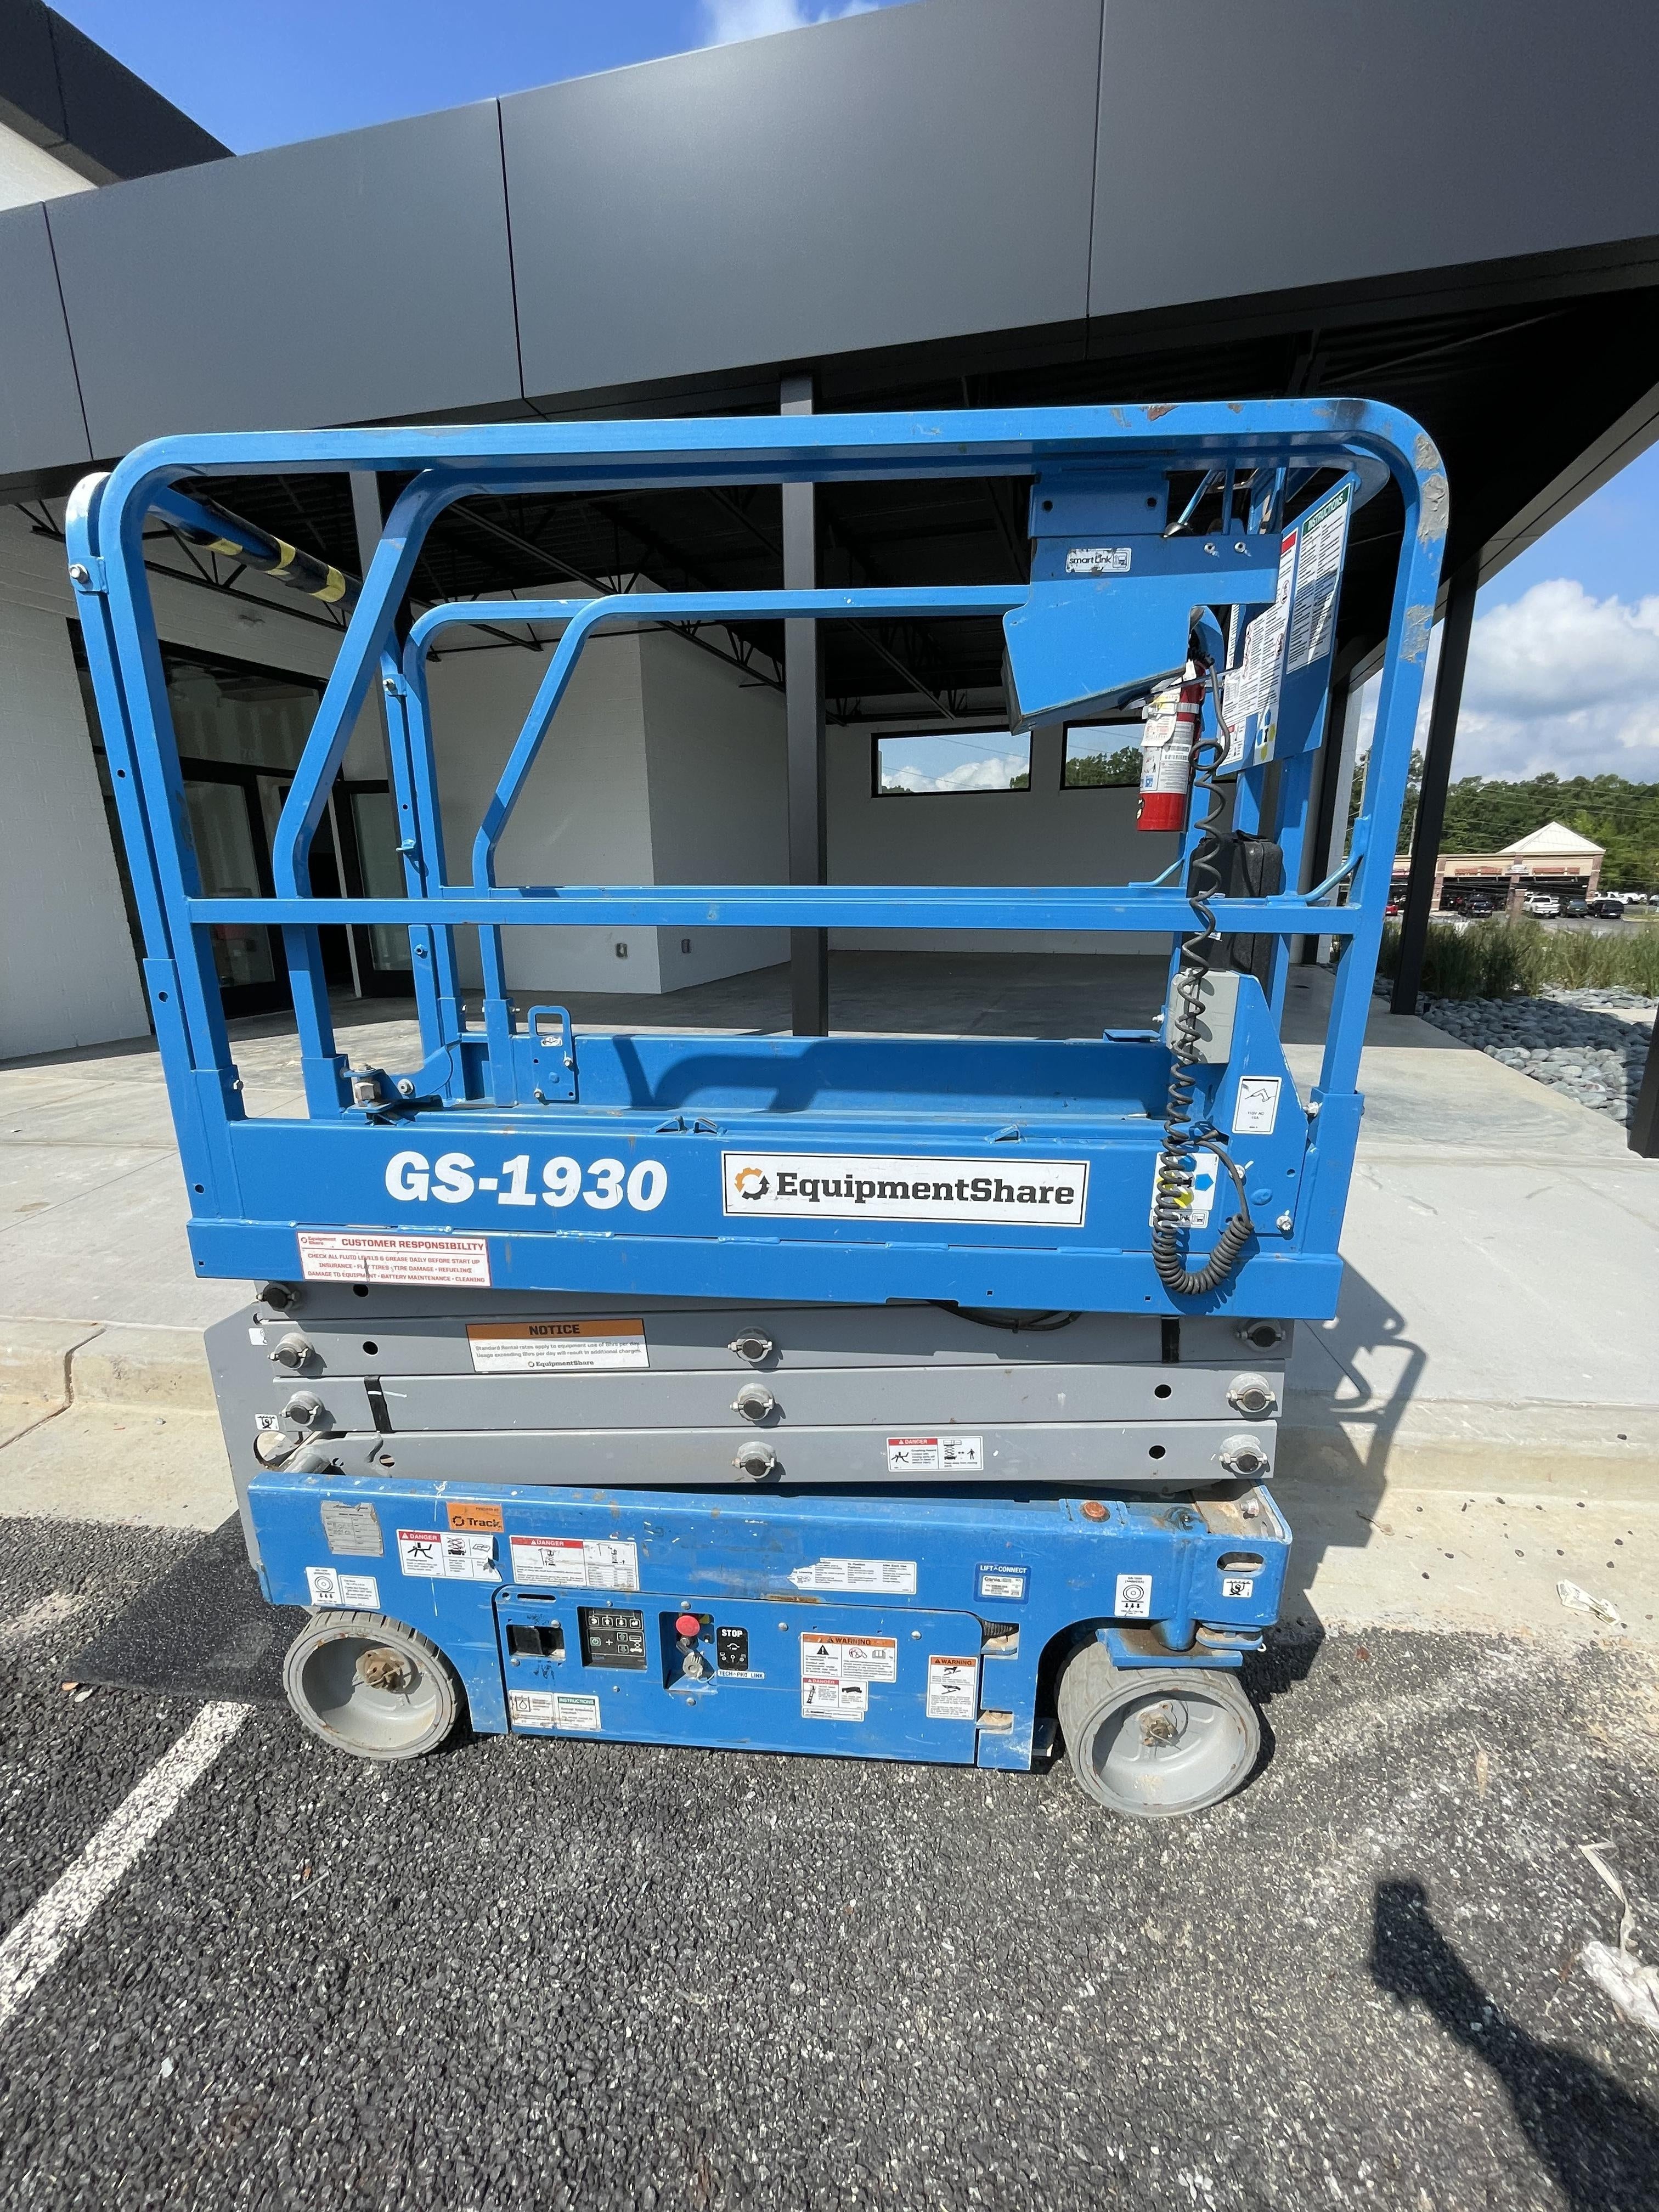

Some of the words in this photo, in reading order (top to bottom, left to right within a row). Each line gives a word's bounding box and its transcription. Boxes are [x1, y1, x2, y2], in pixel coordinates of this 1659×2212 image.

[1308, 493, 1344, 531] INSTRUCTIONS
[385, 1151, 668, 1211] GS-1930
[776, 1172, 1075, 1205] EquipmentShare
[342, 1238, 396, 1248] CUSTOMER
[399, 1240, 484, 1251] RESPONSIBILITY
[529, 1324, 580, 1335] NOTICE
[467, 1517, 500, 1527] Track
[721, 1629, 743, 1638] STOP
